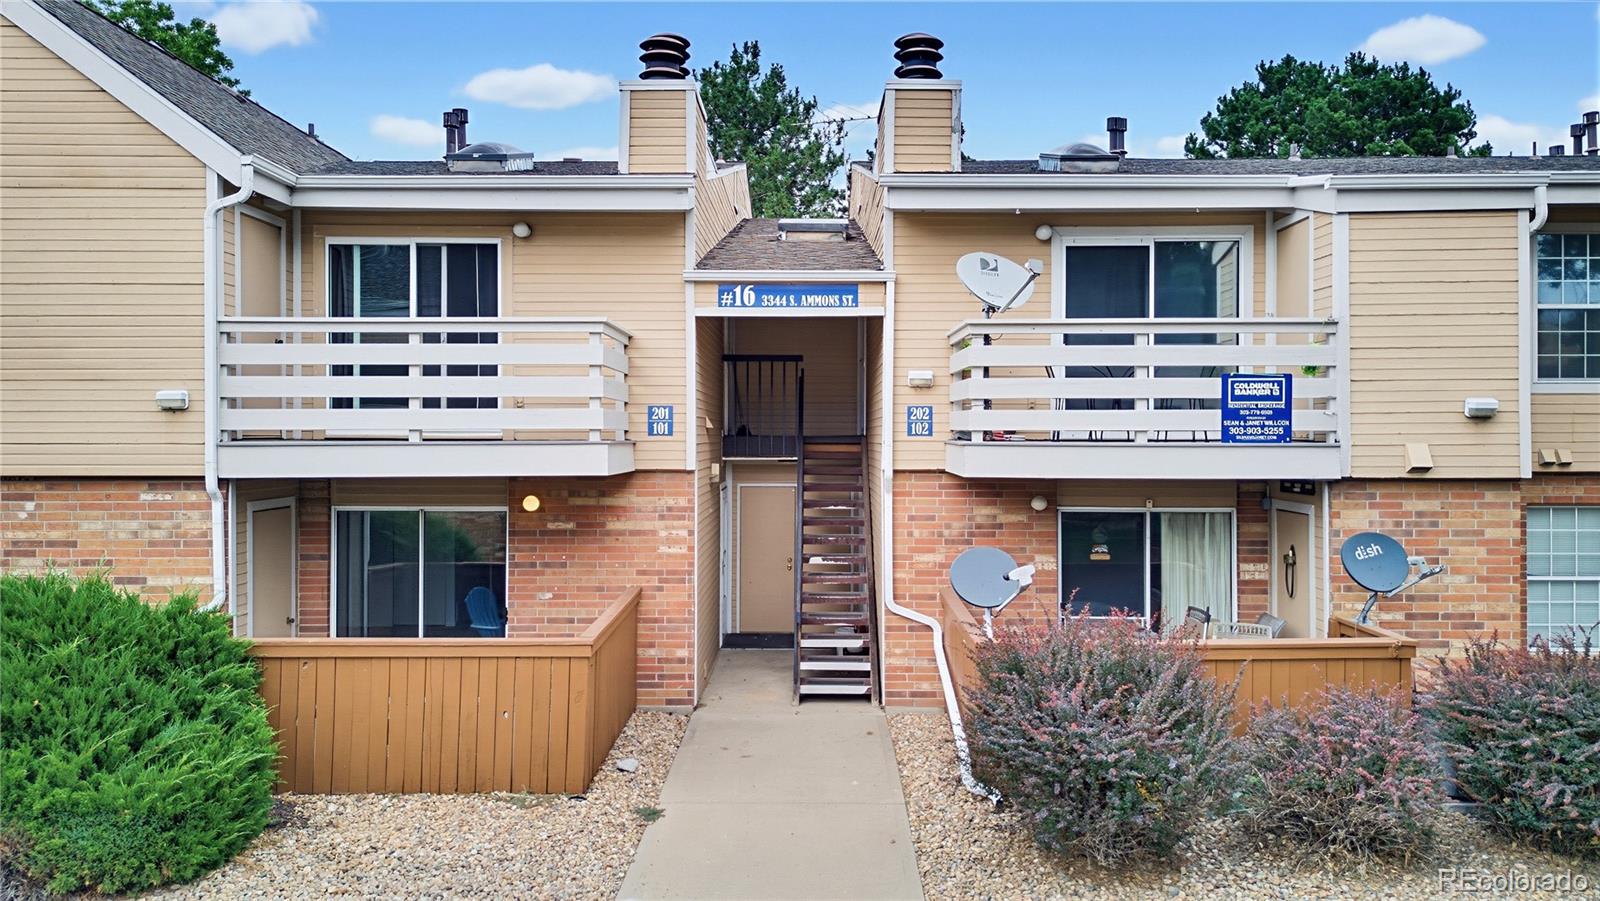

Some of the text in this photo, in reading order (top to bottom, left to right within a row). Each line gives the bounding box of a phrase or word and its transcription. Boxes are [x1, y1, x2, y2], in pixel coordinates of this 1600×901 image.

[721, 285, 856, 307] #16 3344 S. AMMONS ST.
[1234, 388, 1271, 396] BANKER
[652, 407, 669, 420] 201
[910, 407, 930, 420] 202
[653, 422, 669, 435] 101
[911, 422, 929, 435] 102
[1355, 543, 1383, 560] dish
